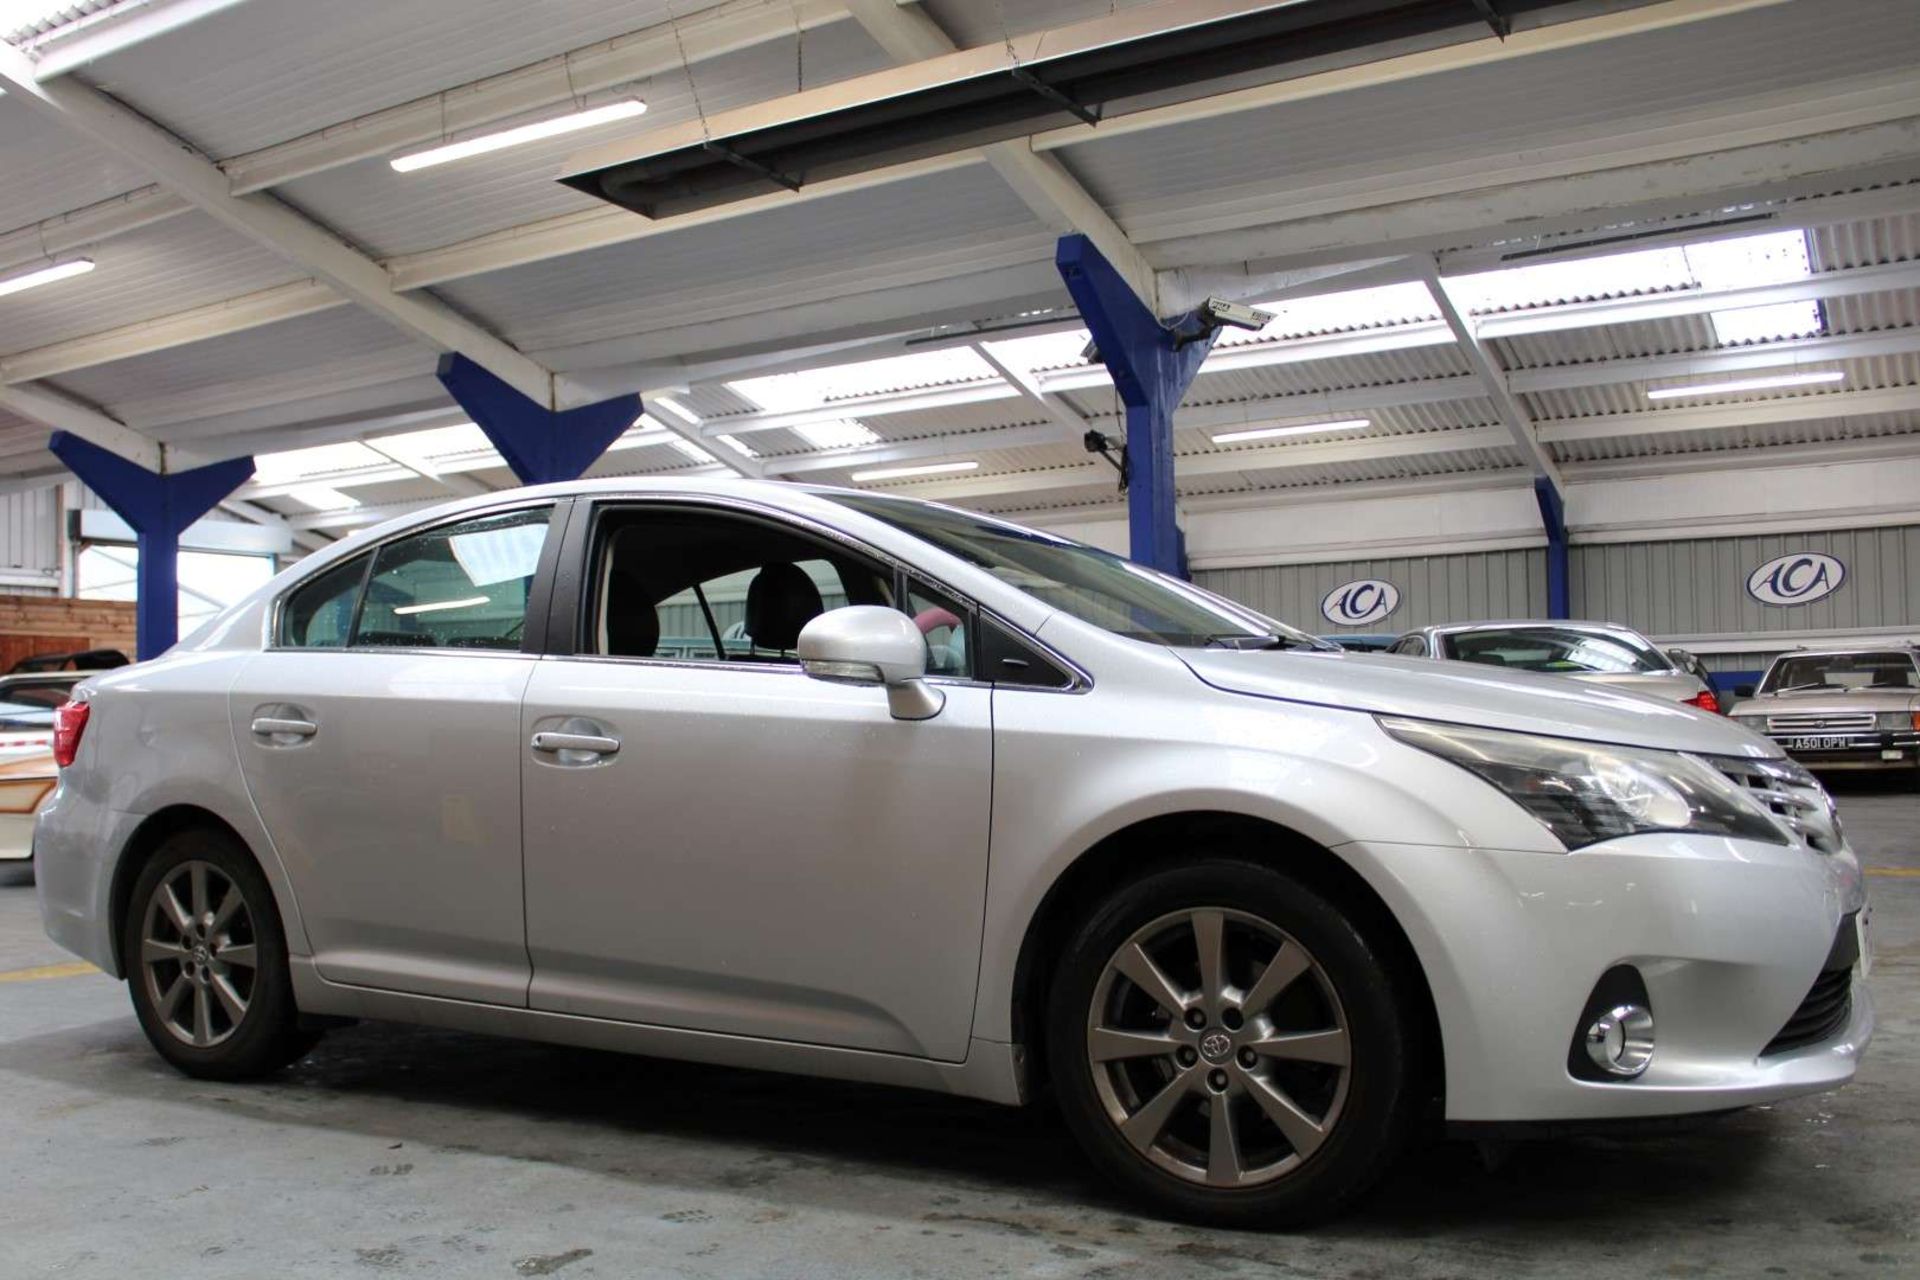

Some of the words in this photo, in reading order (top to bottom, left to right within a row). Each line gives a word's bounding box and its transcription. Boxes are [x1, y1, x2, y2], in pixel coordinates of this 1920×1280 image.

[1754, 558, 1829, 597] ACA
[1327, 584, 1387, 619] ACA
[1795, 737, 1821, 749] A501
